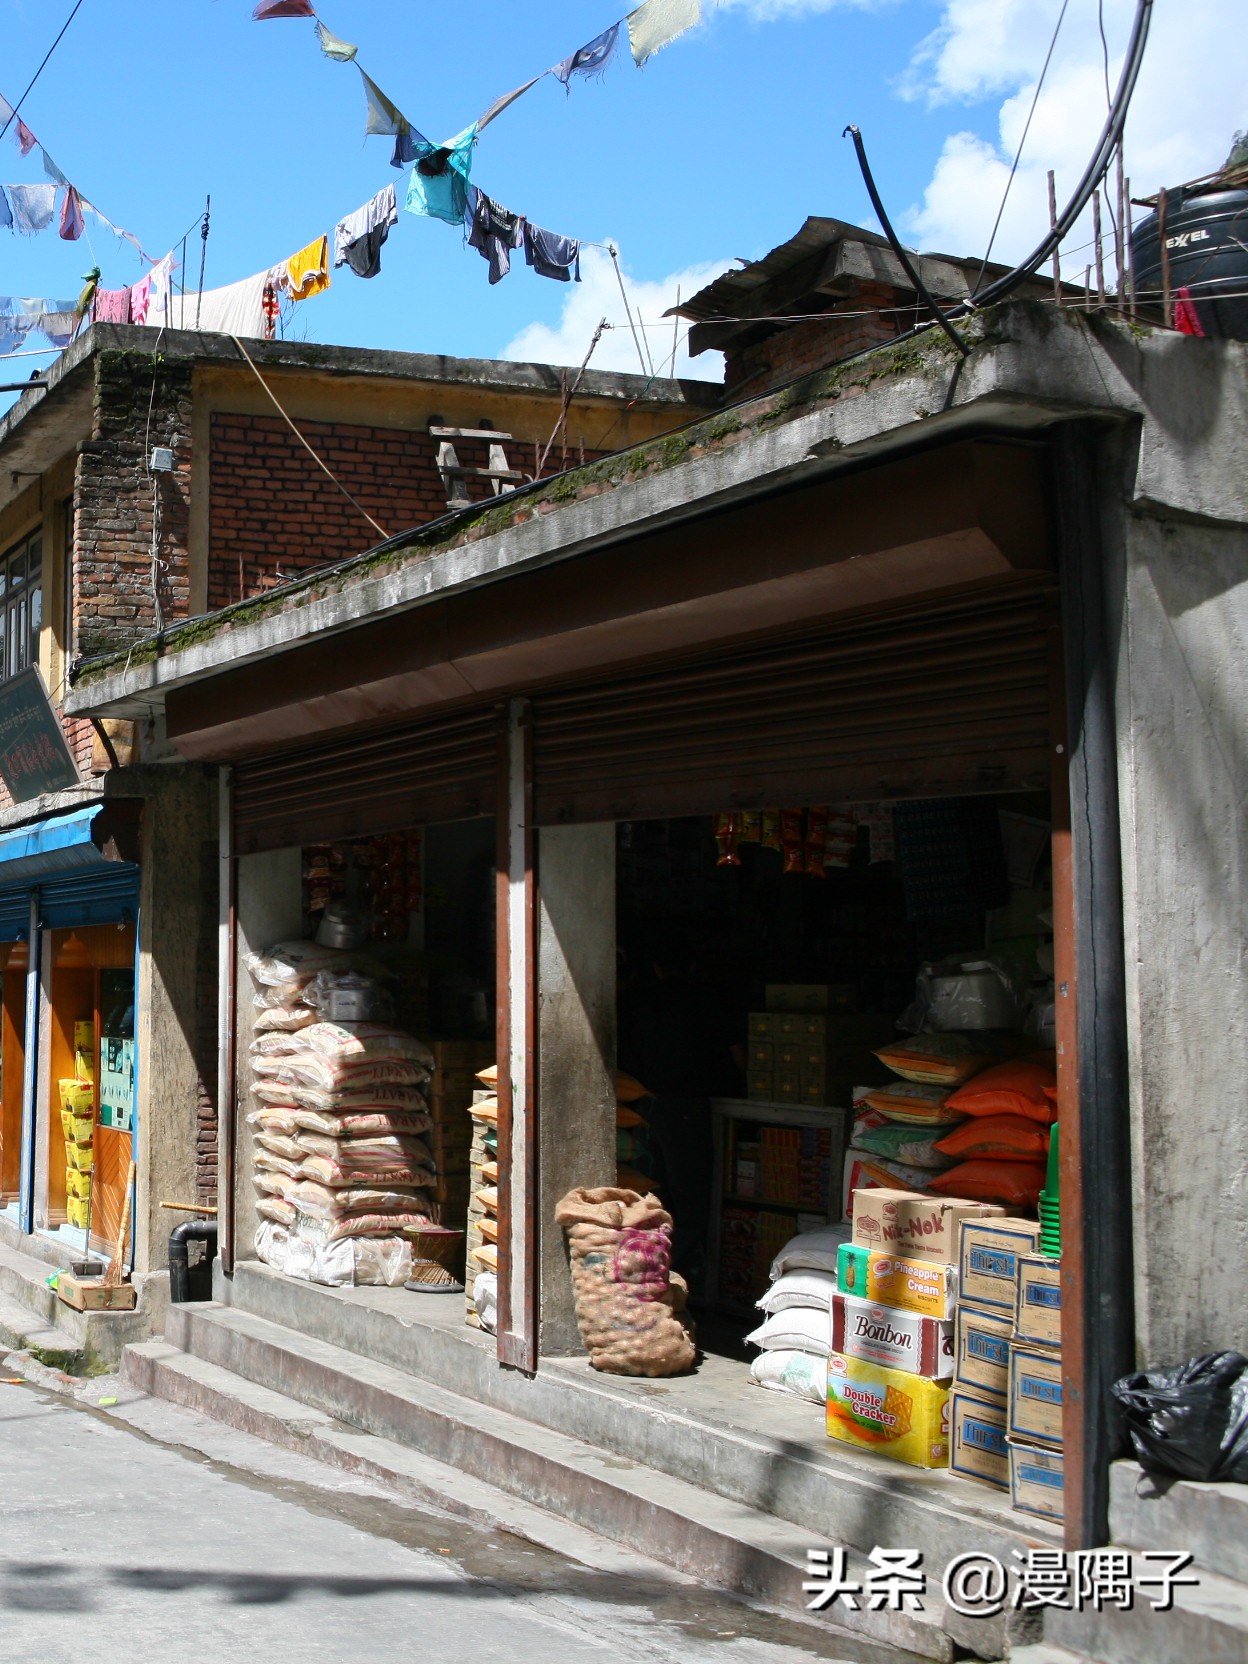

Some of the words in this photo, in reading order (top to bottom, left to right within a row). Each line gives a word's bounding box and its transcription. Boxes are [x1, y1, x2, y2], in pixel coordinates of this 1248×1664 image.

[882, 1212, 944, 1242] Nik-Nok
[894, 1261, 940, 1282] Pineapple
[907, 1279, 940, 1297] Cream
[917, 1294, 939, 1304] BISCUITS
[854, 1314, 912, 1350] Bonbon
[843, 1384, 881, 1408] Double
[852, 1401, 897, 1425] Cracker
